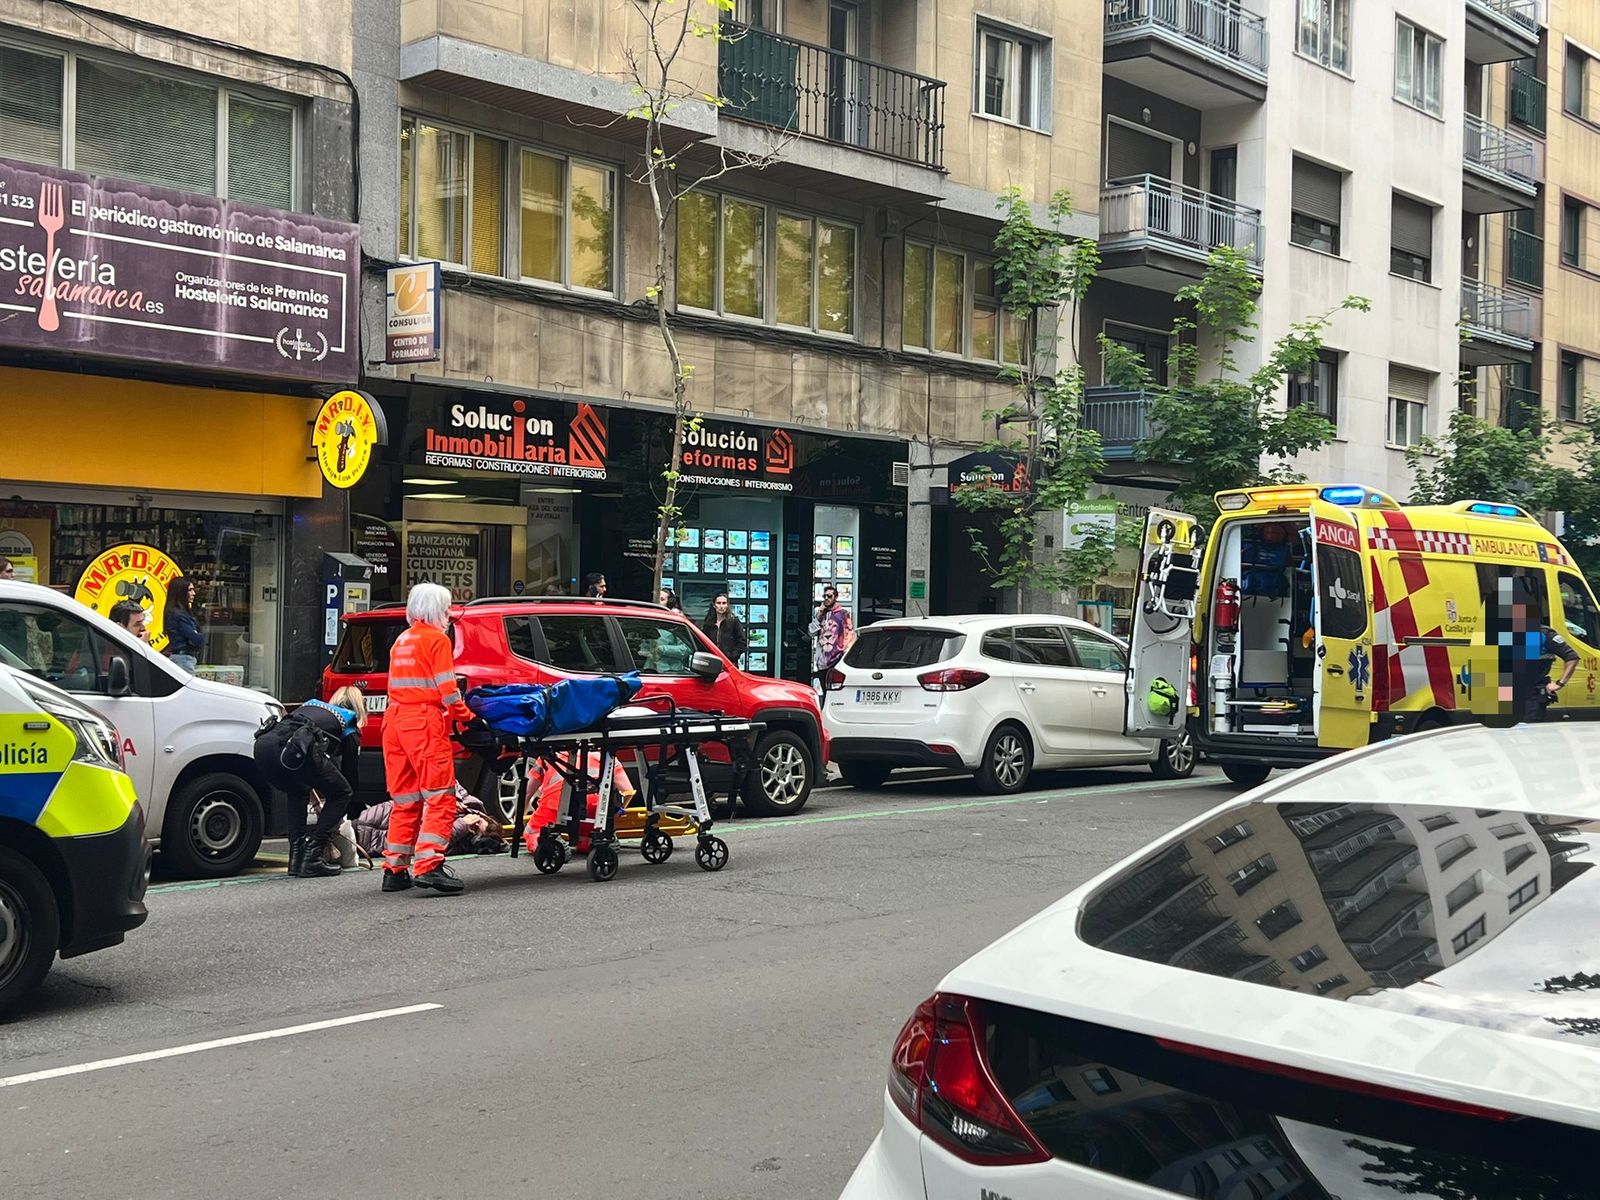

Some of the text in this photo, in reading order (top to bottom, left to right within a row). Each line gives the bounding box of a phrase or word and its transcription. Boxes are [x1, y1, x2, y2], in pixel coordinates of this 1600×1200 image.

[11, 194, 35, 210] 523
[71, 200, 347, 262] El periódico gastronómico de Salamanca
[15, 274, 164, 315] salamanca.es
[175, 272, 330, 305] Organizadores de los Premios
[175, 284, 329, 320] Hostelería Salamanca
[393, 336, 428, 346] CENTRO DE
[391, 346, 430, 359] FORMACIÓN
[425, 454, 607, 481] REFORMAS CONSTRUCCIONES INTERIORISMO
[680, 449, 758, 472] eformas
[675, 474, 793, 492] CONSTRUCCIONES INTERIORISMO
[1080, 504, 1114, 512] Herbolario
[420, 547, 464, 558] FONTANA
[1475, 539, 1537, 558] AMBULANCIA
[327, 584, 338, 605] P
[862, 691, 899, 701] 1986 KKY
